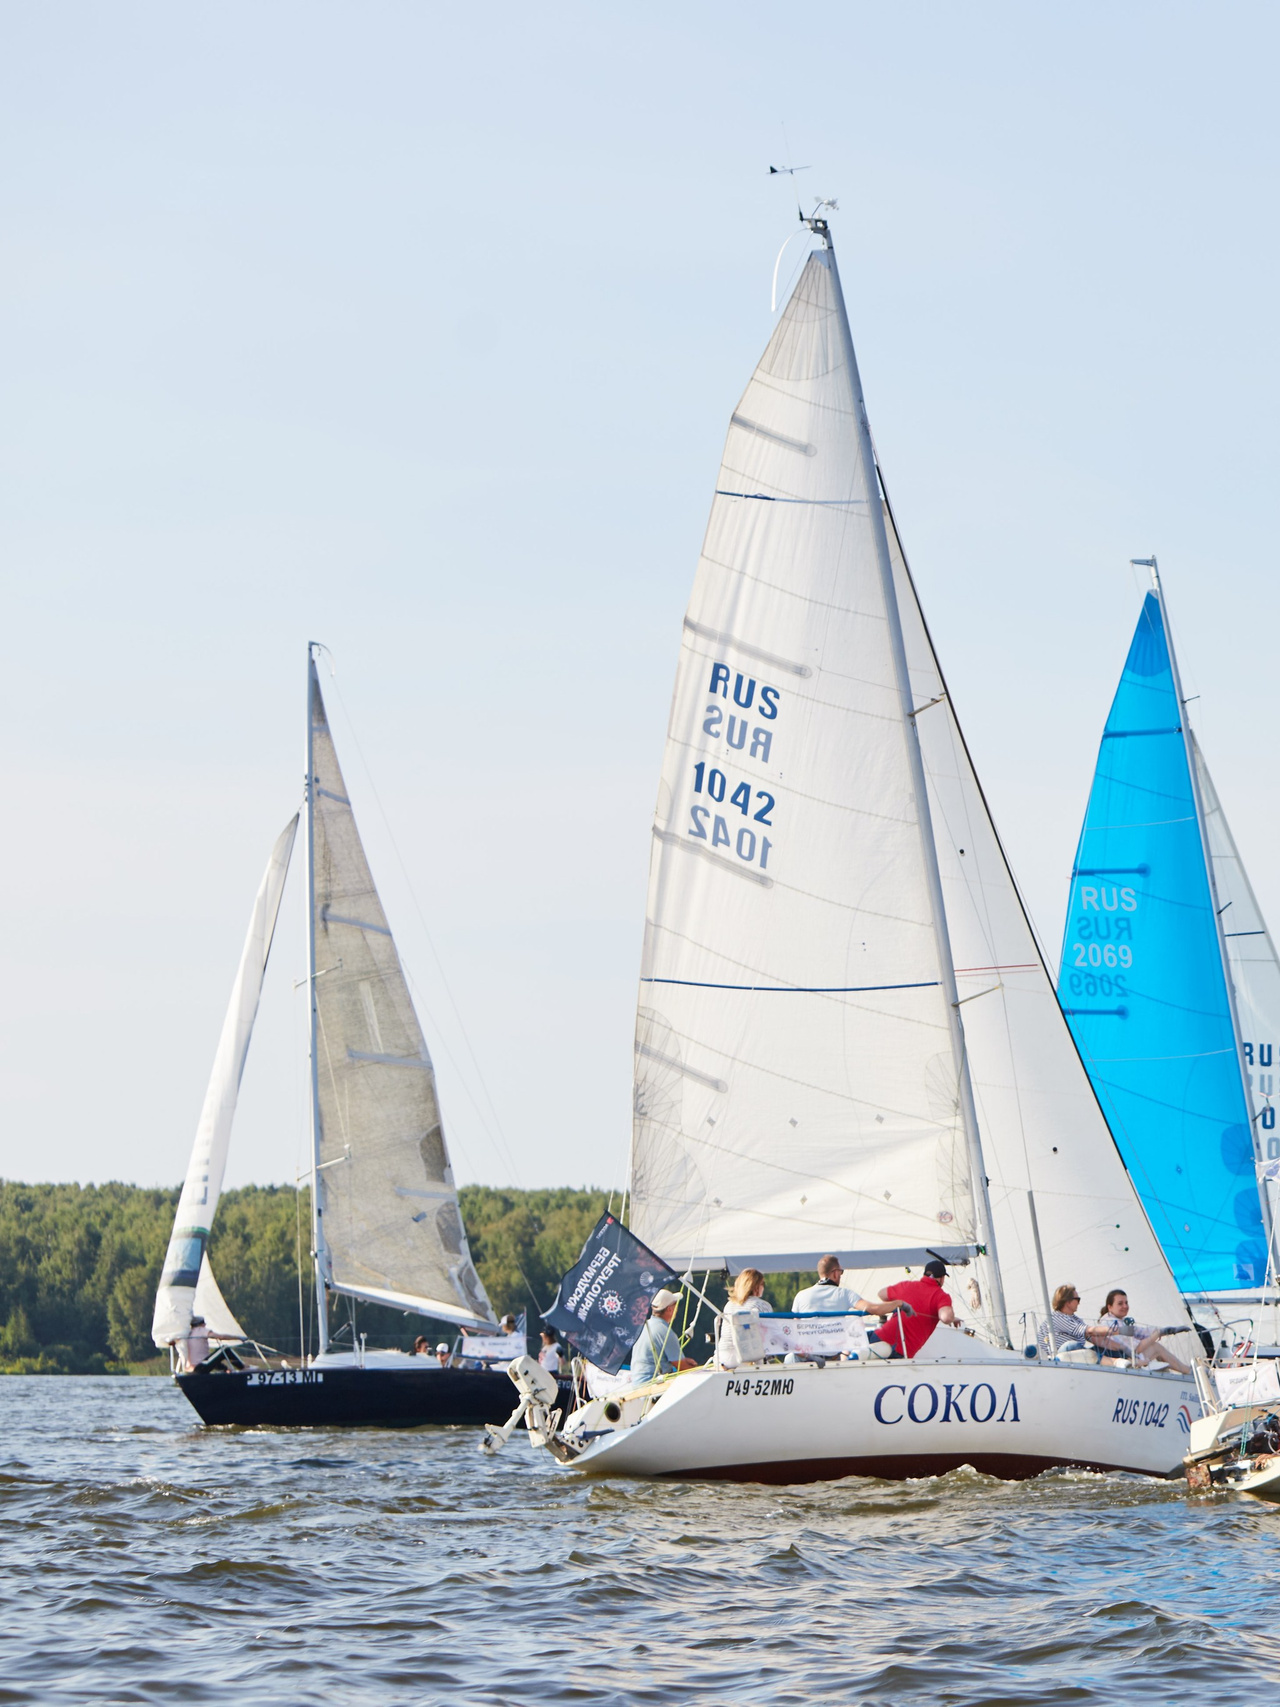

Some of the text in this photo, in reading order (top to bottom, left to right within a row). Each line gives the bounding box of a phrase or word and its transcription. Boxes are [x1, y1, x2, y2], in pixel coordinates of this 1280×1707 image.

[709, 662, 780, 720] RUS
[694, 761, 775, 826] 1042
[1081, 886, 1137, 912] RUS
[1072, 943, 1133, 968] 2069
[725, 1378, 795, 1397] Р49-52МЮ
[873, 1382, 1021, 1425] СОКОЛ
[1112, 1398, 1169, 1428] RUS 1042
